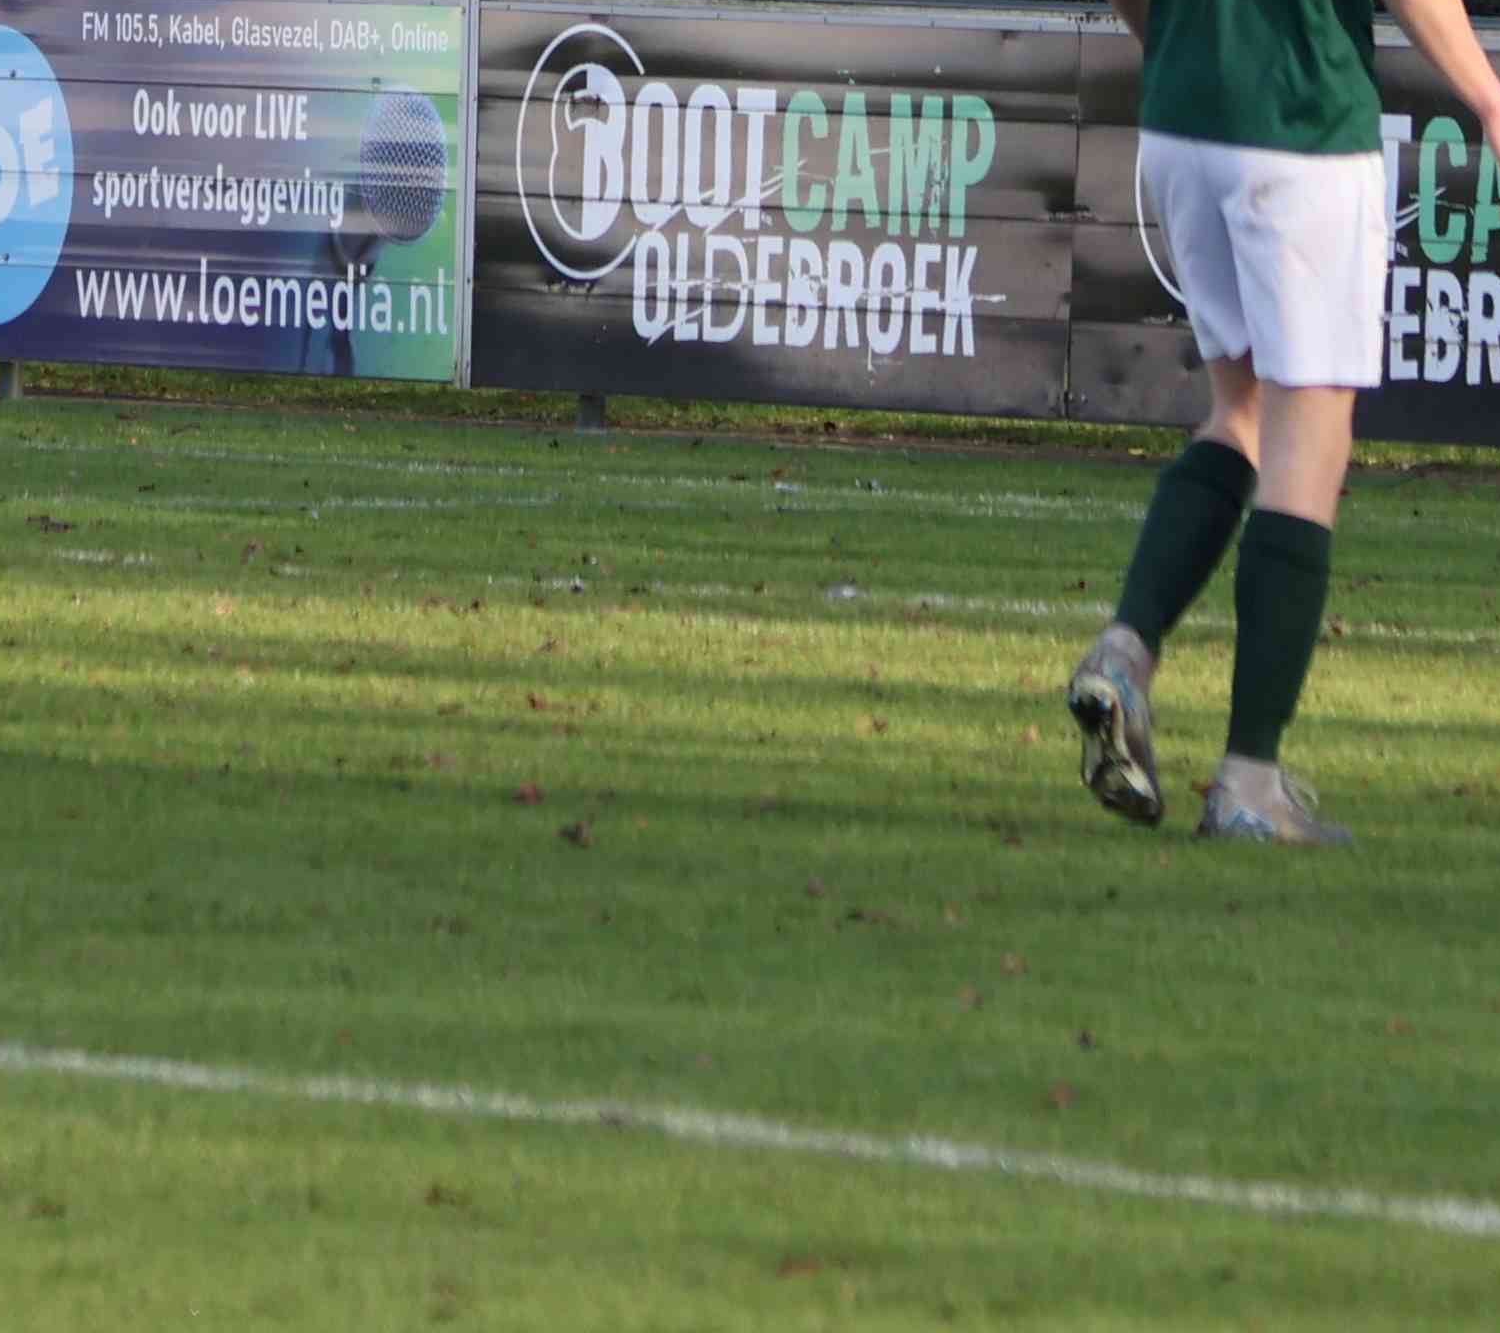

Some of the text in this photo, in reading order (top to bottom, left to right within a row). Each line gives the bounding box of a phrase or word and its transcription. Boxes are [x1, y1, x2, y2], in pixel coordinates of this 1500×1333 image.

[81, 12, 449, 55] FM 105.5, Kabel, Glasvezel, DAB+, Online
[132, 88, 308, 142] Ook voor LIVE
[92, 163, 344, 229] sportverslaggeving
[75, 256, 448, 335] www.loemedia.nl
[631, 231, 980, 357] OLDEBROEK
